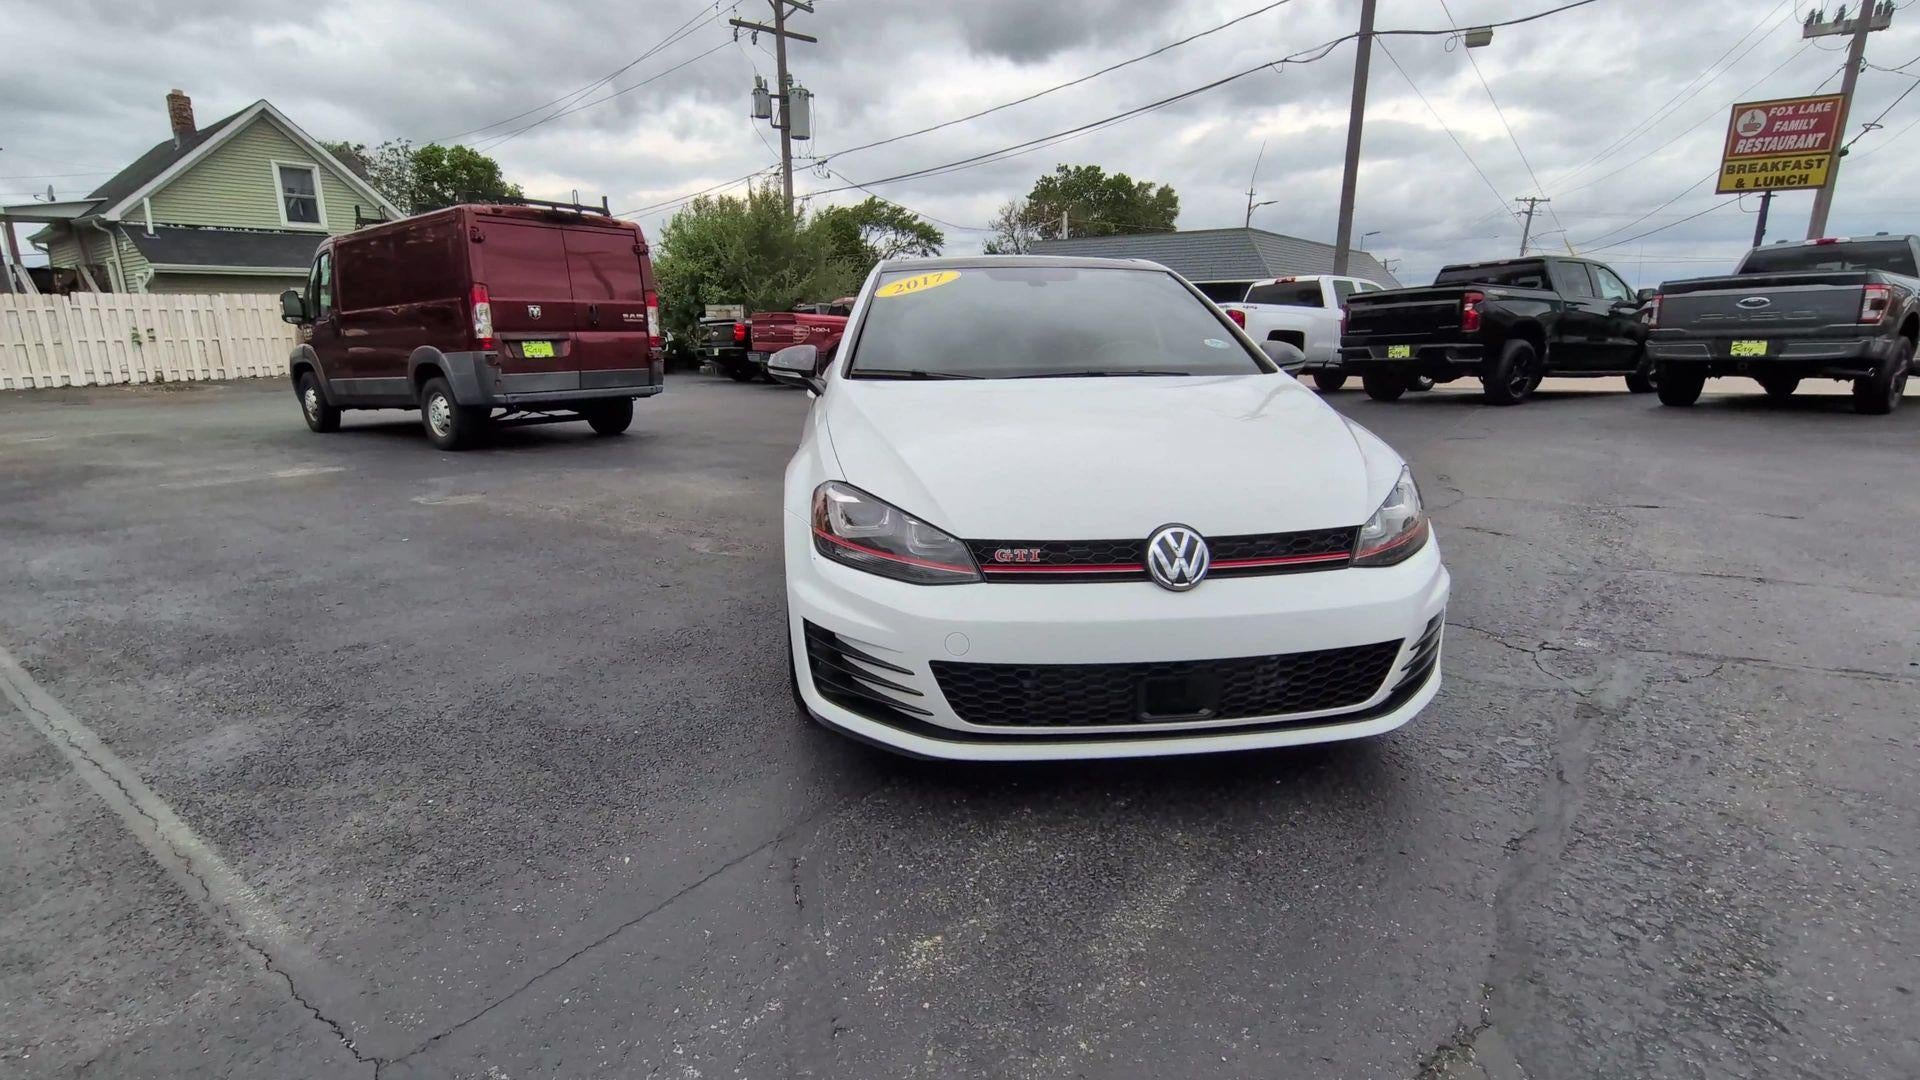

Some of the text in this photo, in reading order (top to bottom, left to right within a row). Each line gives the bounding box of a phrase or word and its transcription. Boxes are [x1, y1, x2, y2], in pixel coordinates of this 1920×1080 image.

[1769, 102, 1833, 117] FOX LAKE
[1773, 118, 1818, 132] FAMILY
[1734, 132, 1826, 154] RESTAURANT
[1725, 158, 1825, 175] BREAKFAST
[1735, 174, 1809, 189] & LUNCH
[894, 272, 943, 294] 2017
[994, 548, 1041, 563] GTI
[1149, 526, 1211, 588] VW
